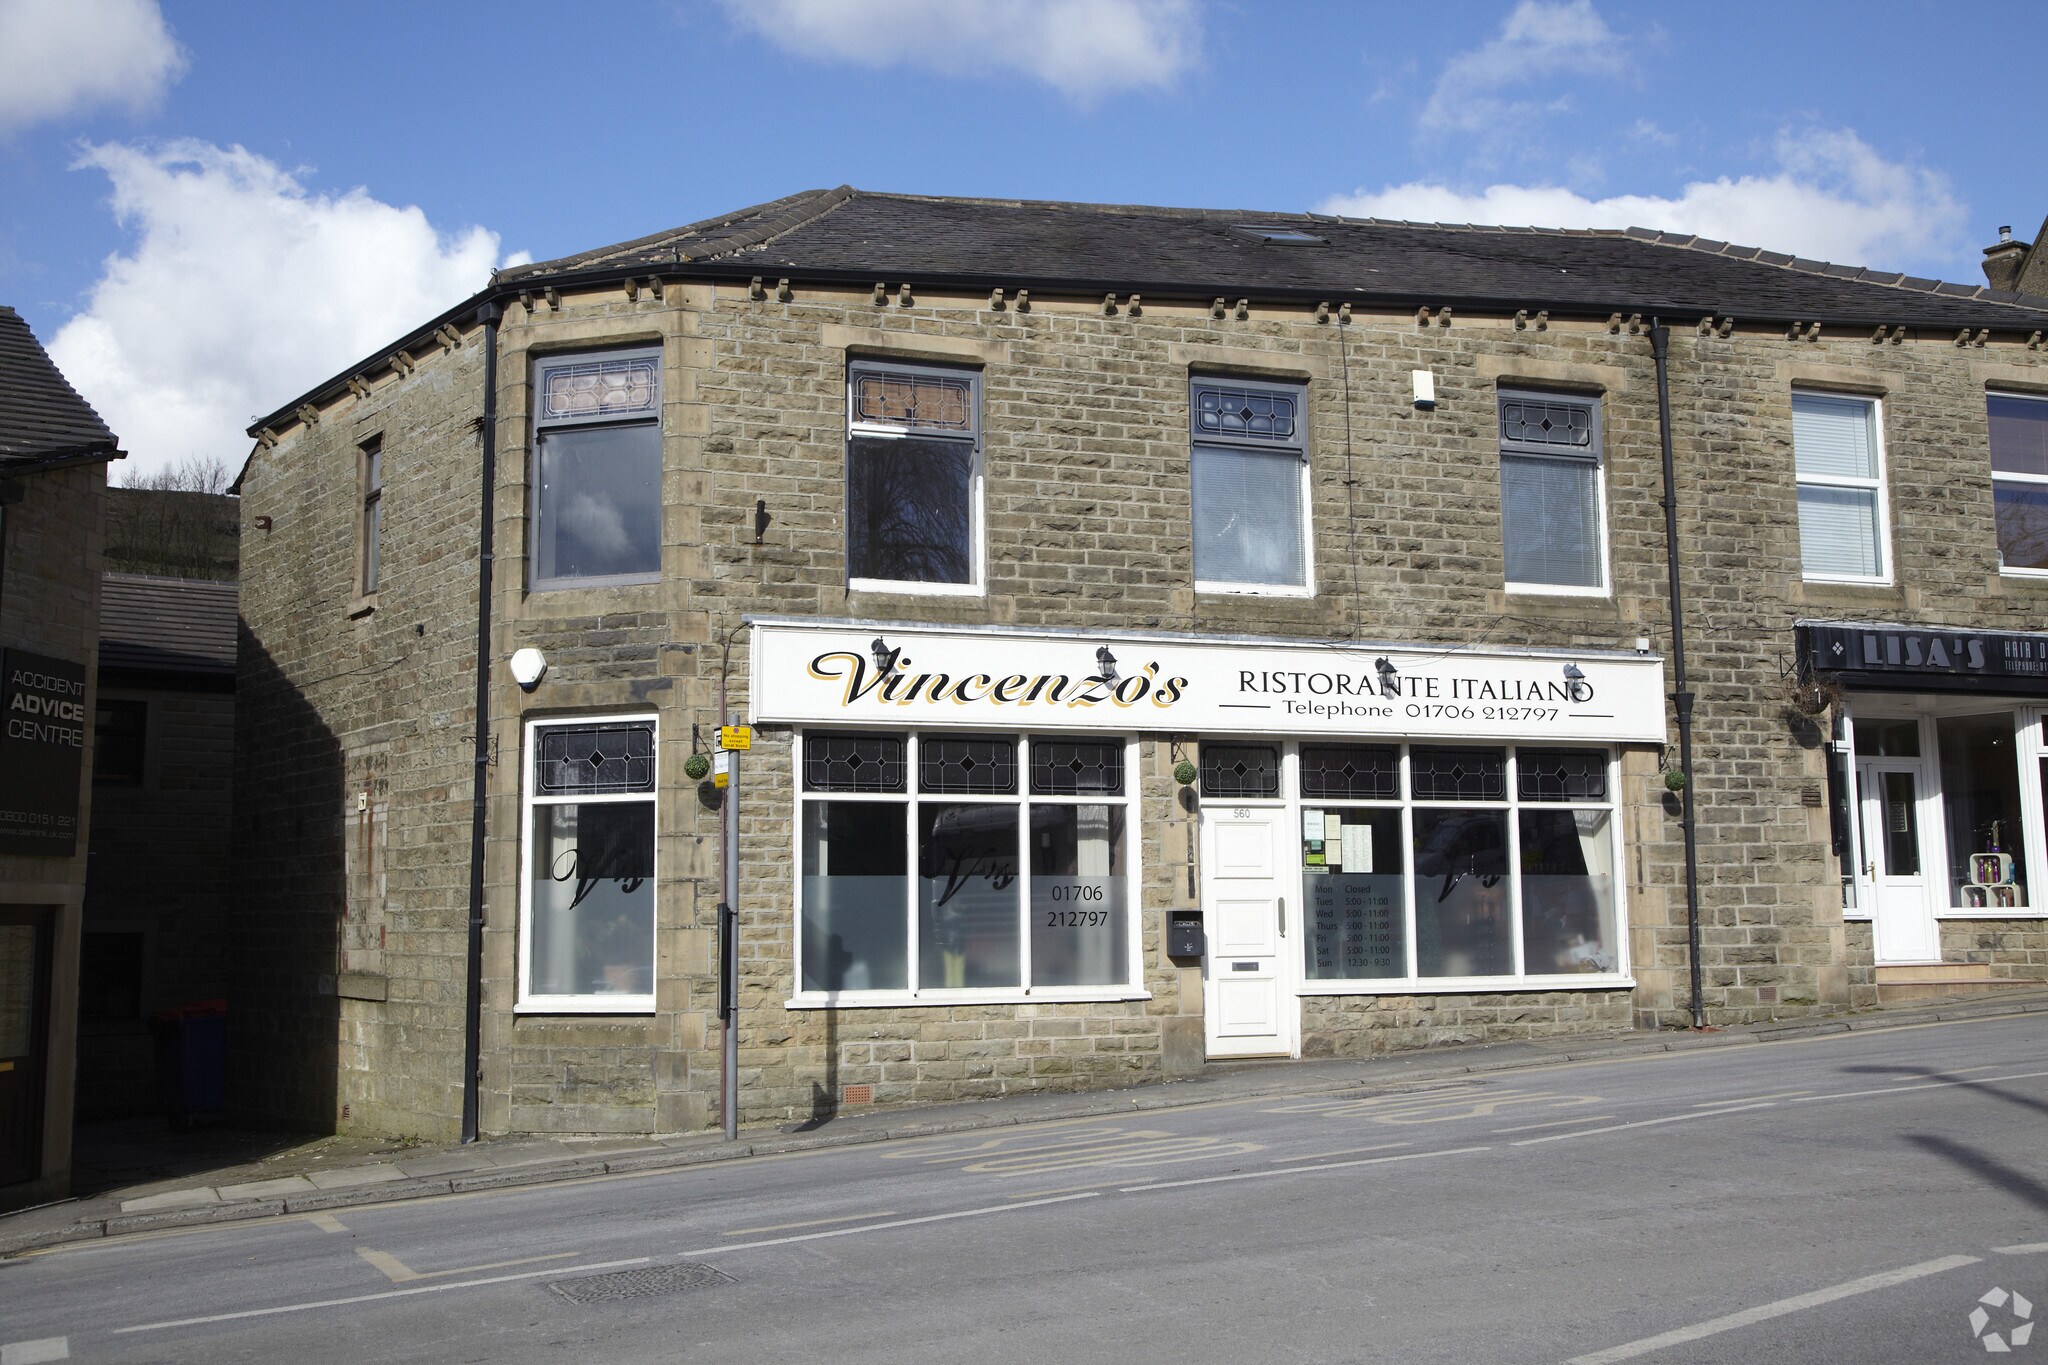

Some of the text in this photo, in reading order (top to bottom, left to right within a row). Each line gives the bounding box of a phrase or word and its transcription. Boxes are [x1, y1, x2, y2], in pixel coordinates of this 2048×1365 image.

[1862, 635, 1985, 669] LISA'S
[2004, 640, 2031, 658] HAIR
[10, 669, 84, 697] ACCIDENT
[806, 646, 1189, 708] Vincenzo's
[1238, 670, 1594, 702] RISTORANTE ITALIANO
[10, 692, 84, 722] ADVICE
[1282, 700, 1559, 722] Telephone 01706 212797
[8, 719, 82, 748] CENTRE
[0, 810, 26, 822] 0800
[29, 813, 54, 825] 0151
[1234, 808, 1250, 819] 560
[1051, 885, 1103, 902] 01706
[1345, 885, 1370, 893] Closed
[1048, 911, 1108, 928] 212797
